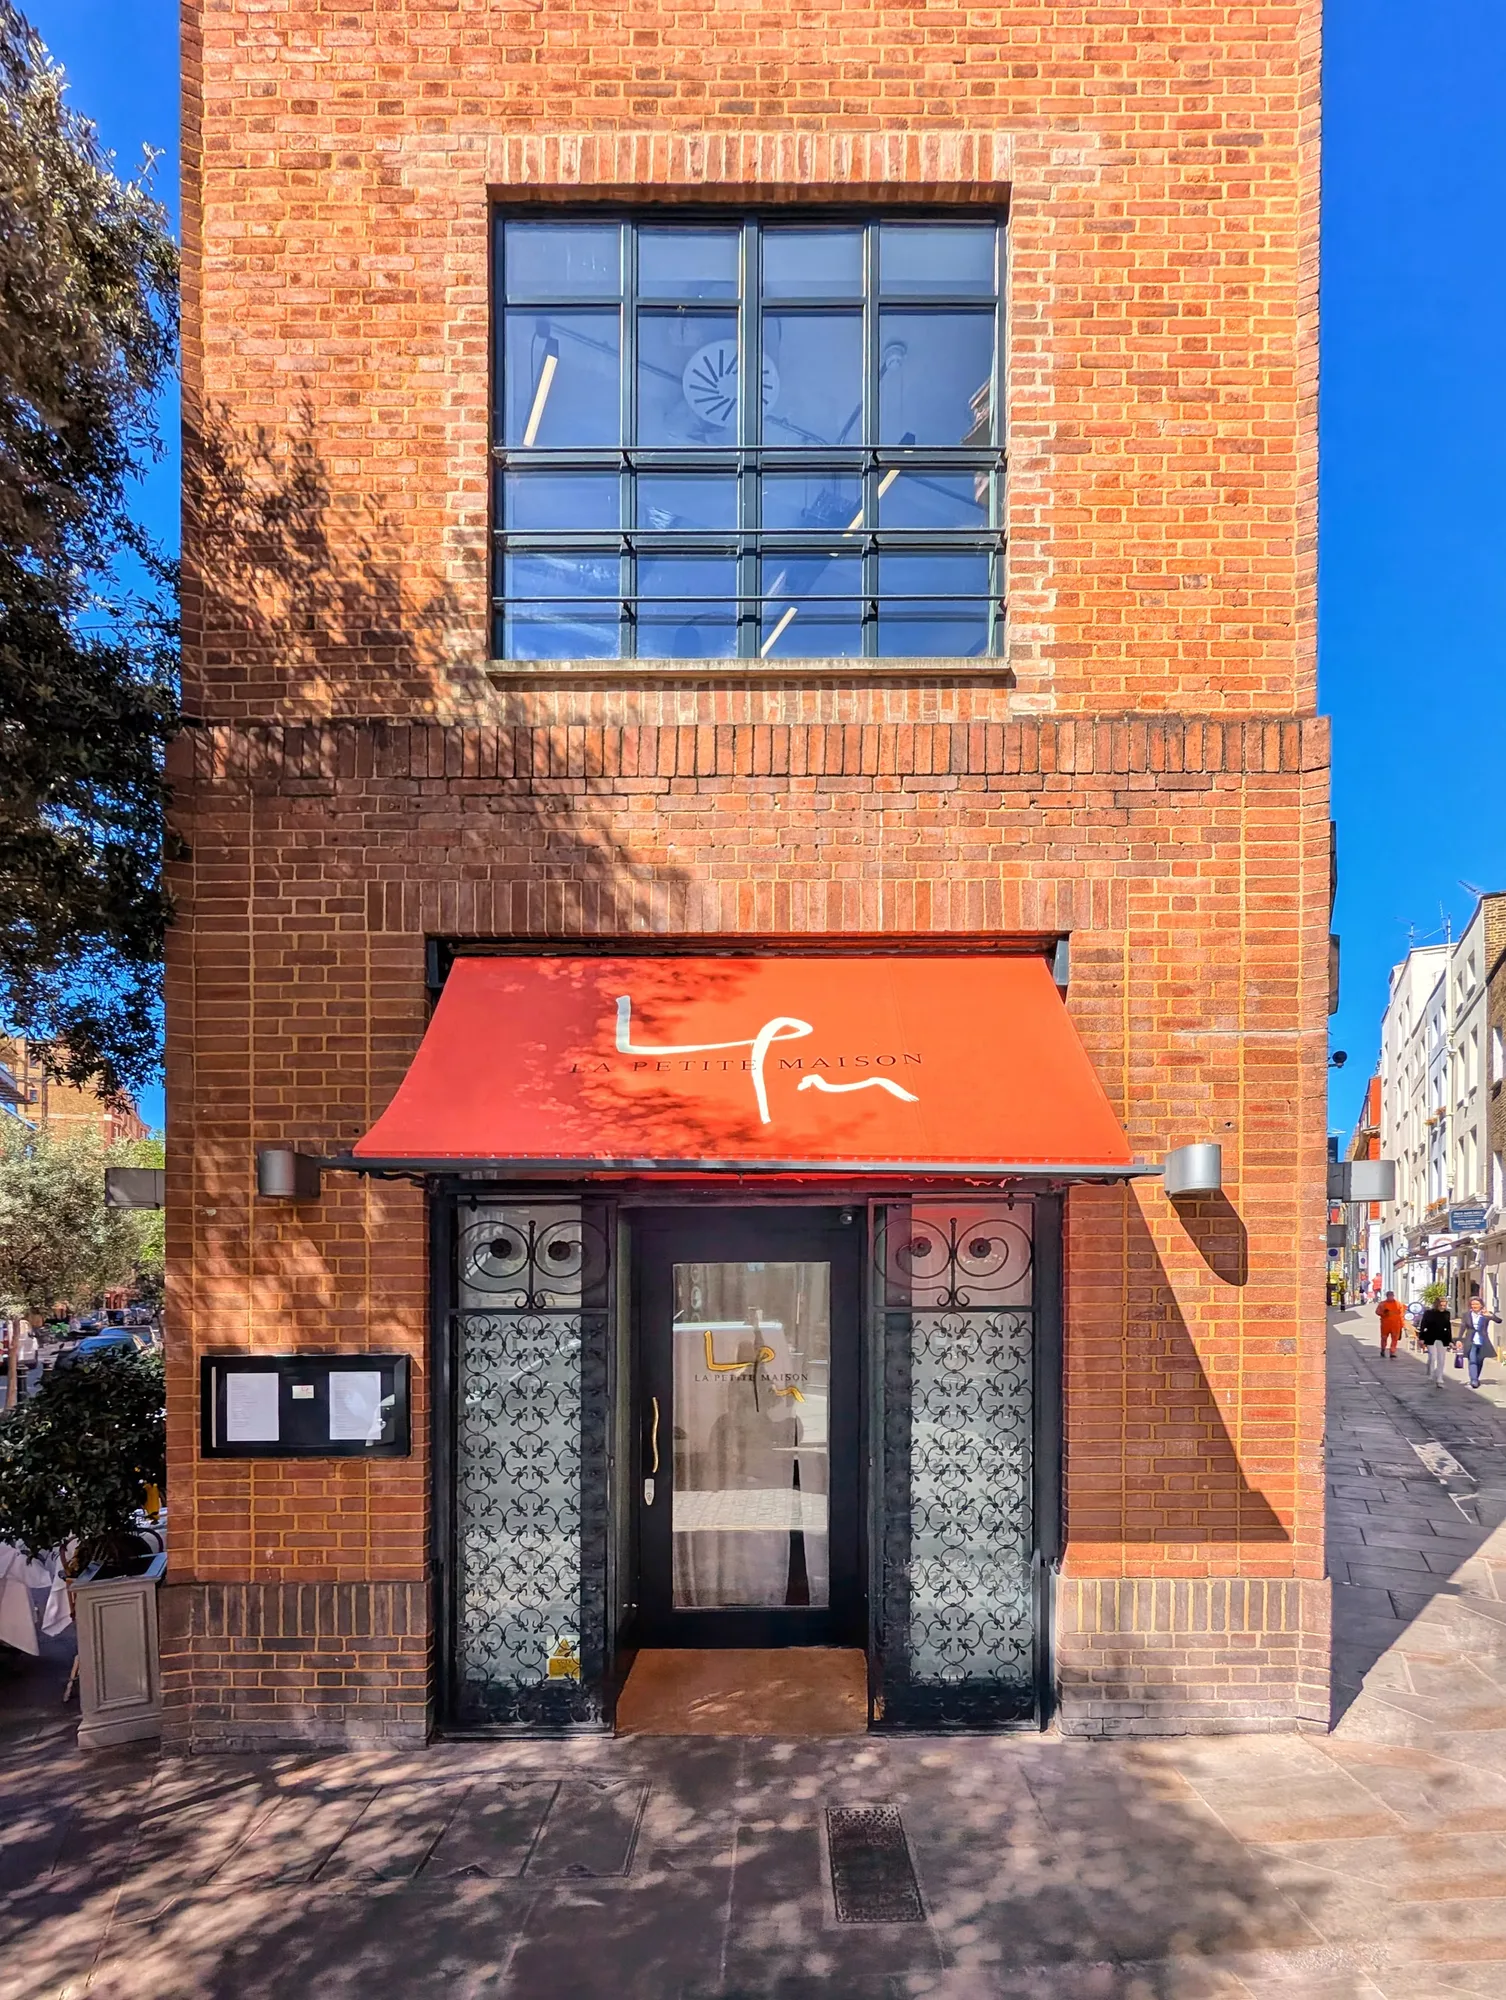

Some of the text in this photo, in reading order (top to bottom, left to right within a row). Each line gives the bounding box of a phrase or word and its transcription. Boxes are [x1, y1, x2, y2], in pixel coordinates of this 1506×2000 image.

[569, 1053, 923, 1074] LA PETITE MAISON
[694, 1374, 710, 1382] LA
[761, 1373, 809, 1382] MAISON
